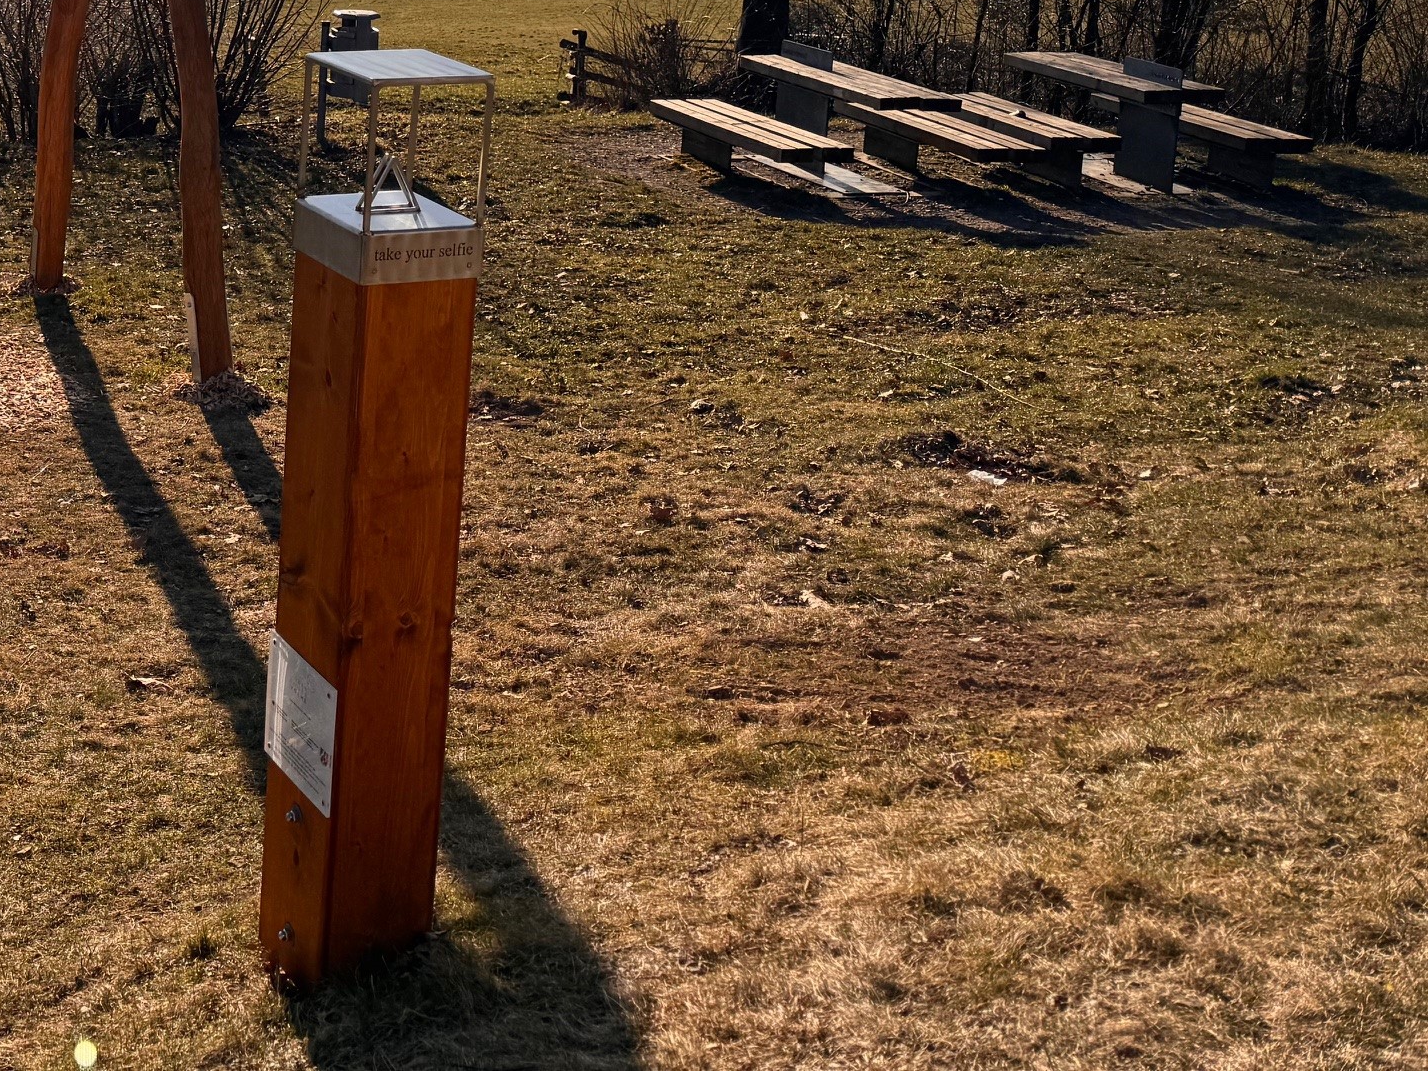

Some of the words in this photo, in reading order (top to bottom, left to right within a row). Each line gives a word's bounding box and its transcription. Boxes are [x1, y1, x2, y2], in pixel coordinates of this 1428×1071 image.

[374, 247, 401, 262] take
[405, 248, 436, 263] your
[438, 242, 473, 258] selfie
